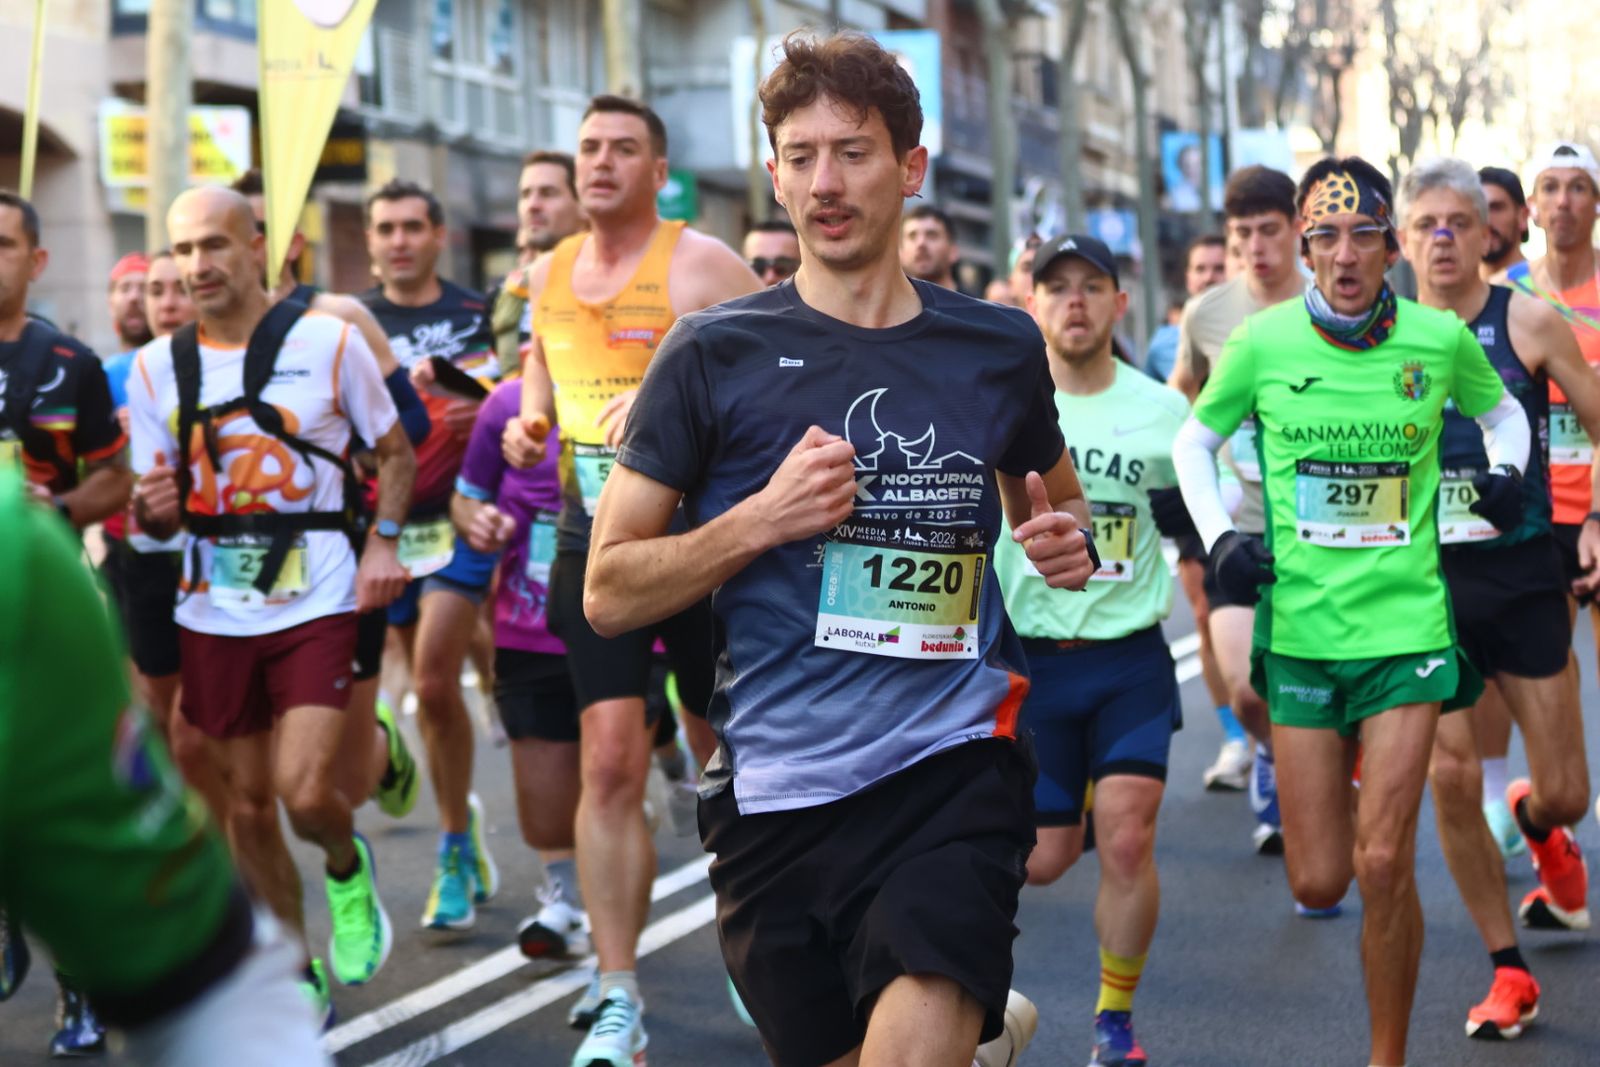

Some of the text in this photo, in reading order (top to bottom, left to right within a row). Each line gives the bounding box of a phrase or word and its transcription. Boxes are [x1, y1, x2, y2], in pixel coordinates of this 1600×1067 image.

[1281, 422, 1418, 443] SANMAXIMO
[1328, 442, 1410, 459] TELECOM
[881, 473, 985, 486] NOCTURNA
[881, 487, 983, 502] ALBACETE
[1326, 483, 1380, 506] 297
[905, 511, 921, 520] de
[834, 525, 956, 545] XIV MEDIA 2026
[863, 553, 964, 595] 1220
[888, 600, 936, 612] ANTONIO
[827, 626, 876, 641] LABORAL
[854, 640, 877, 648] kutxa
[920, 640, 964, 653] bedunia
